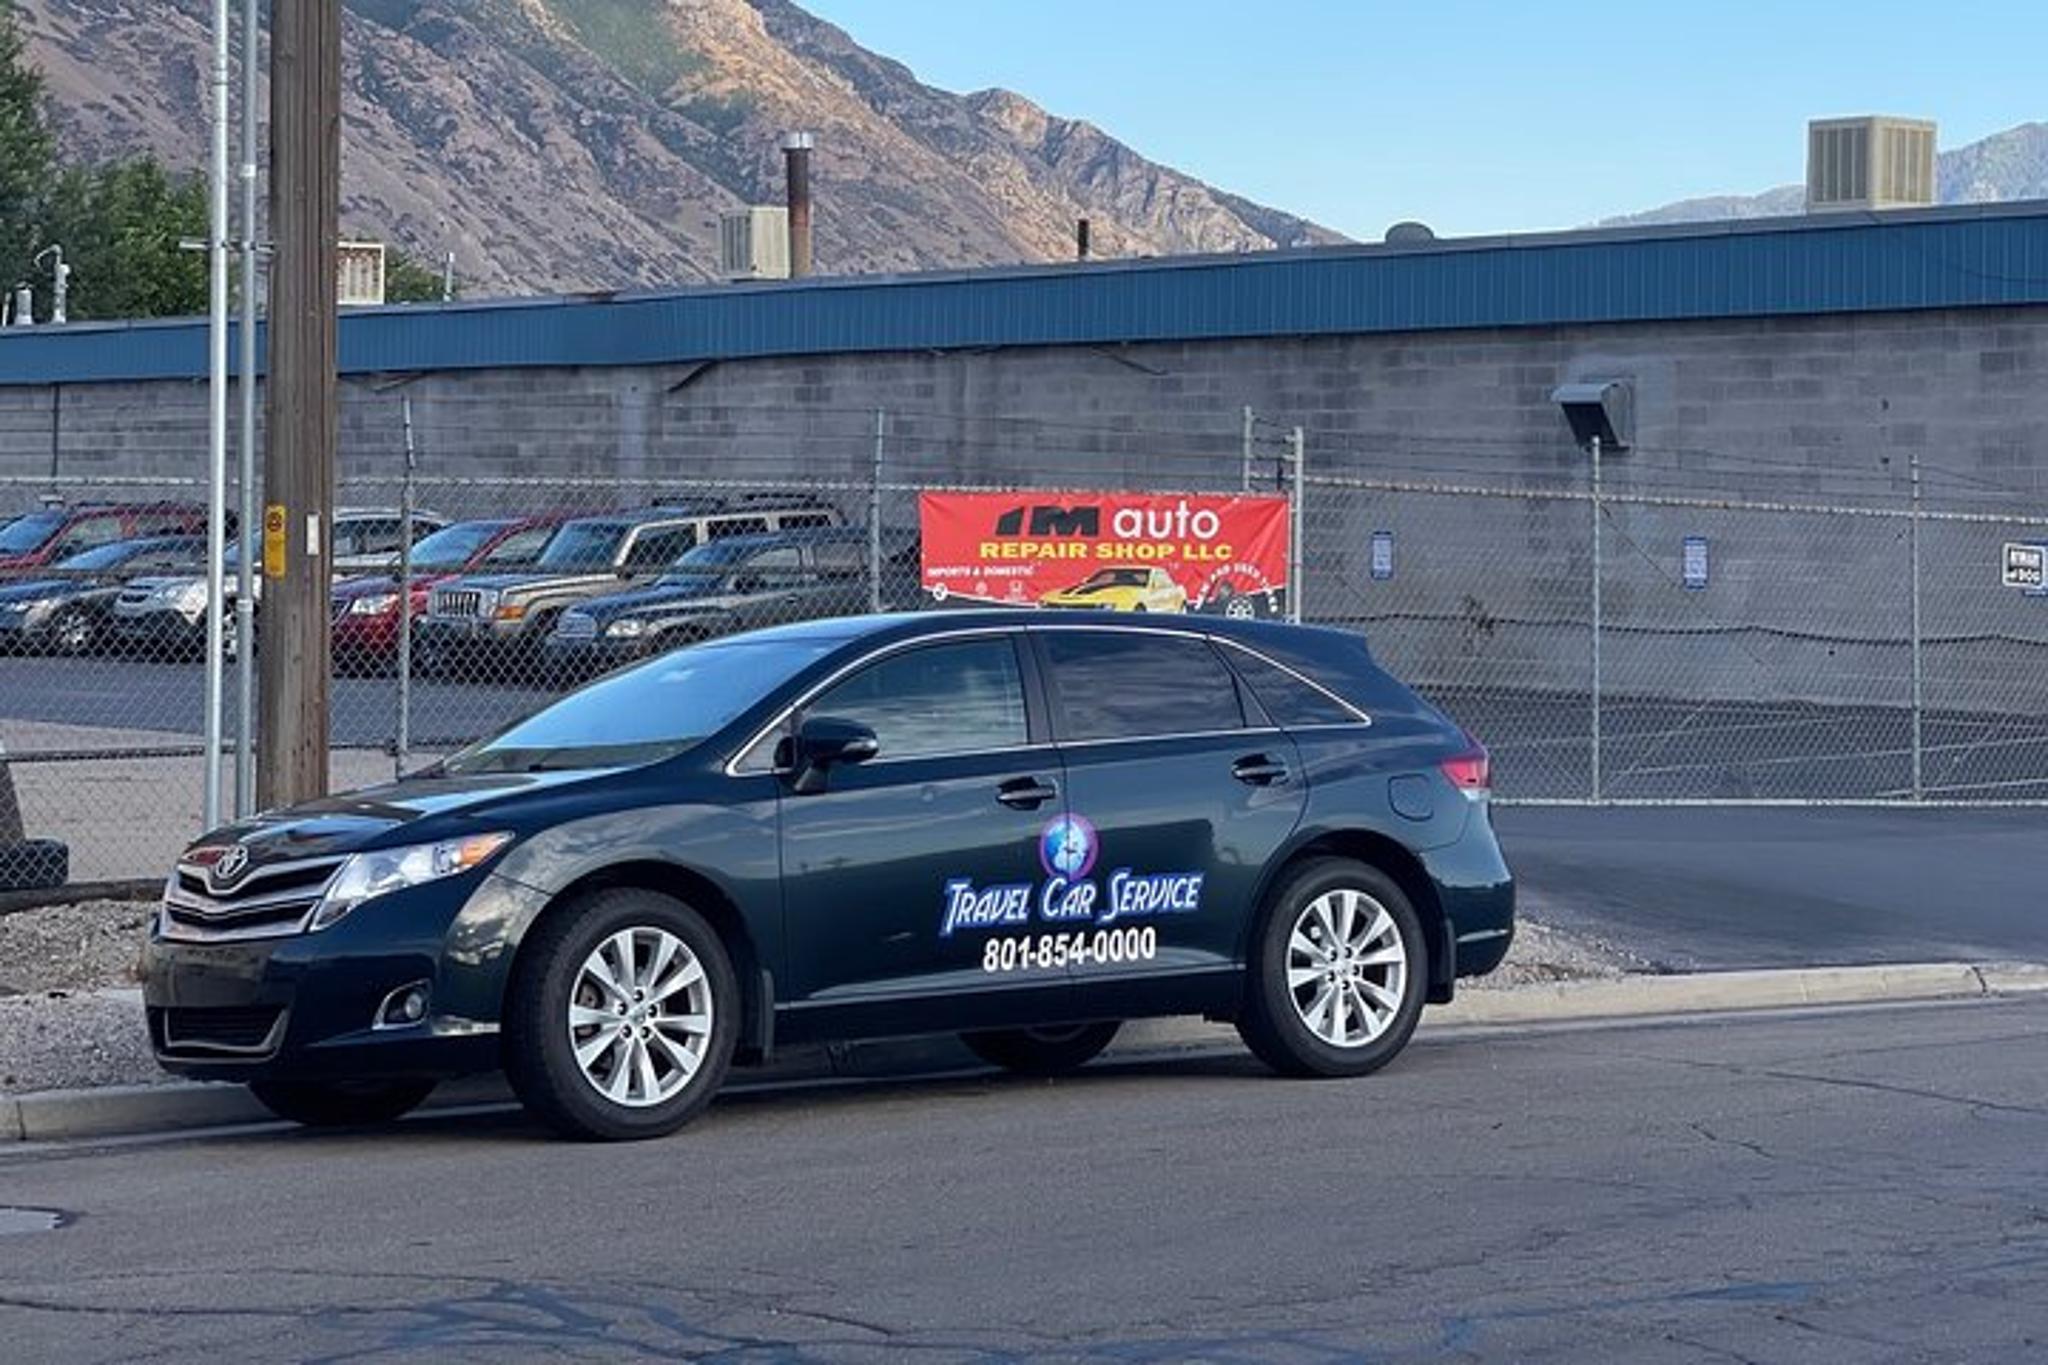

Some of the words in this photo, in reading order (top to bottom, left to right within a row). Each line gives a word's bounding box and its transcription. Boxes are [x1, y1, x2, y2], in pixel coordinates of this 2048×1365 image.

[1113, 500, 1220, 539] auto
[979, 541, 1088, 560] REPAIR
[1095, 541, 1177, 560] SHOP
[1182, 543, 1233, 561] LLC
[982, 926, 1156, 973] 801-854-0000
